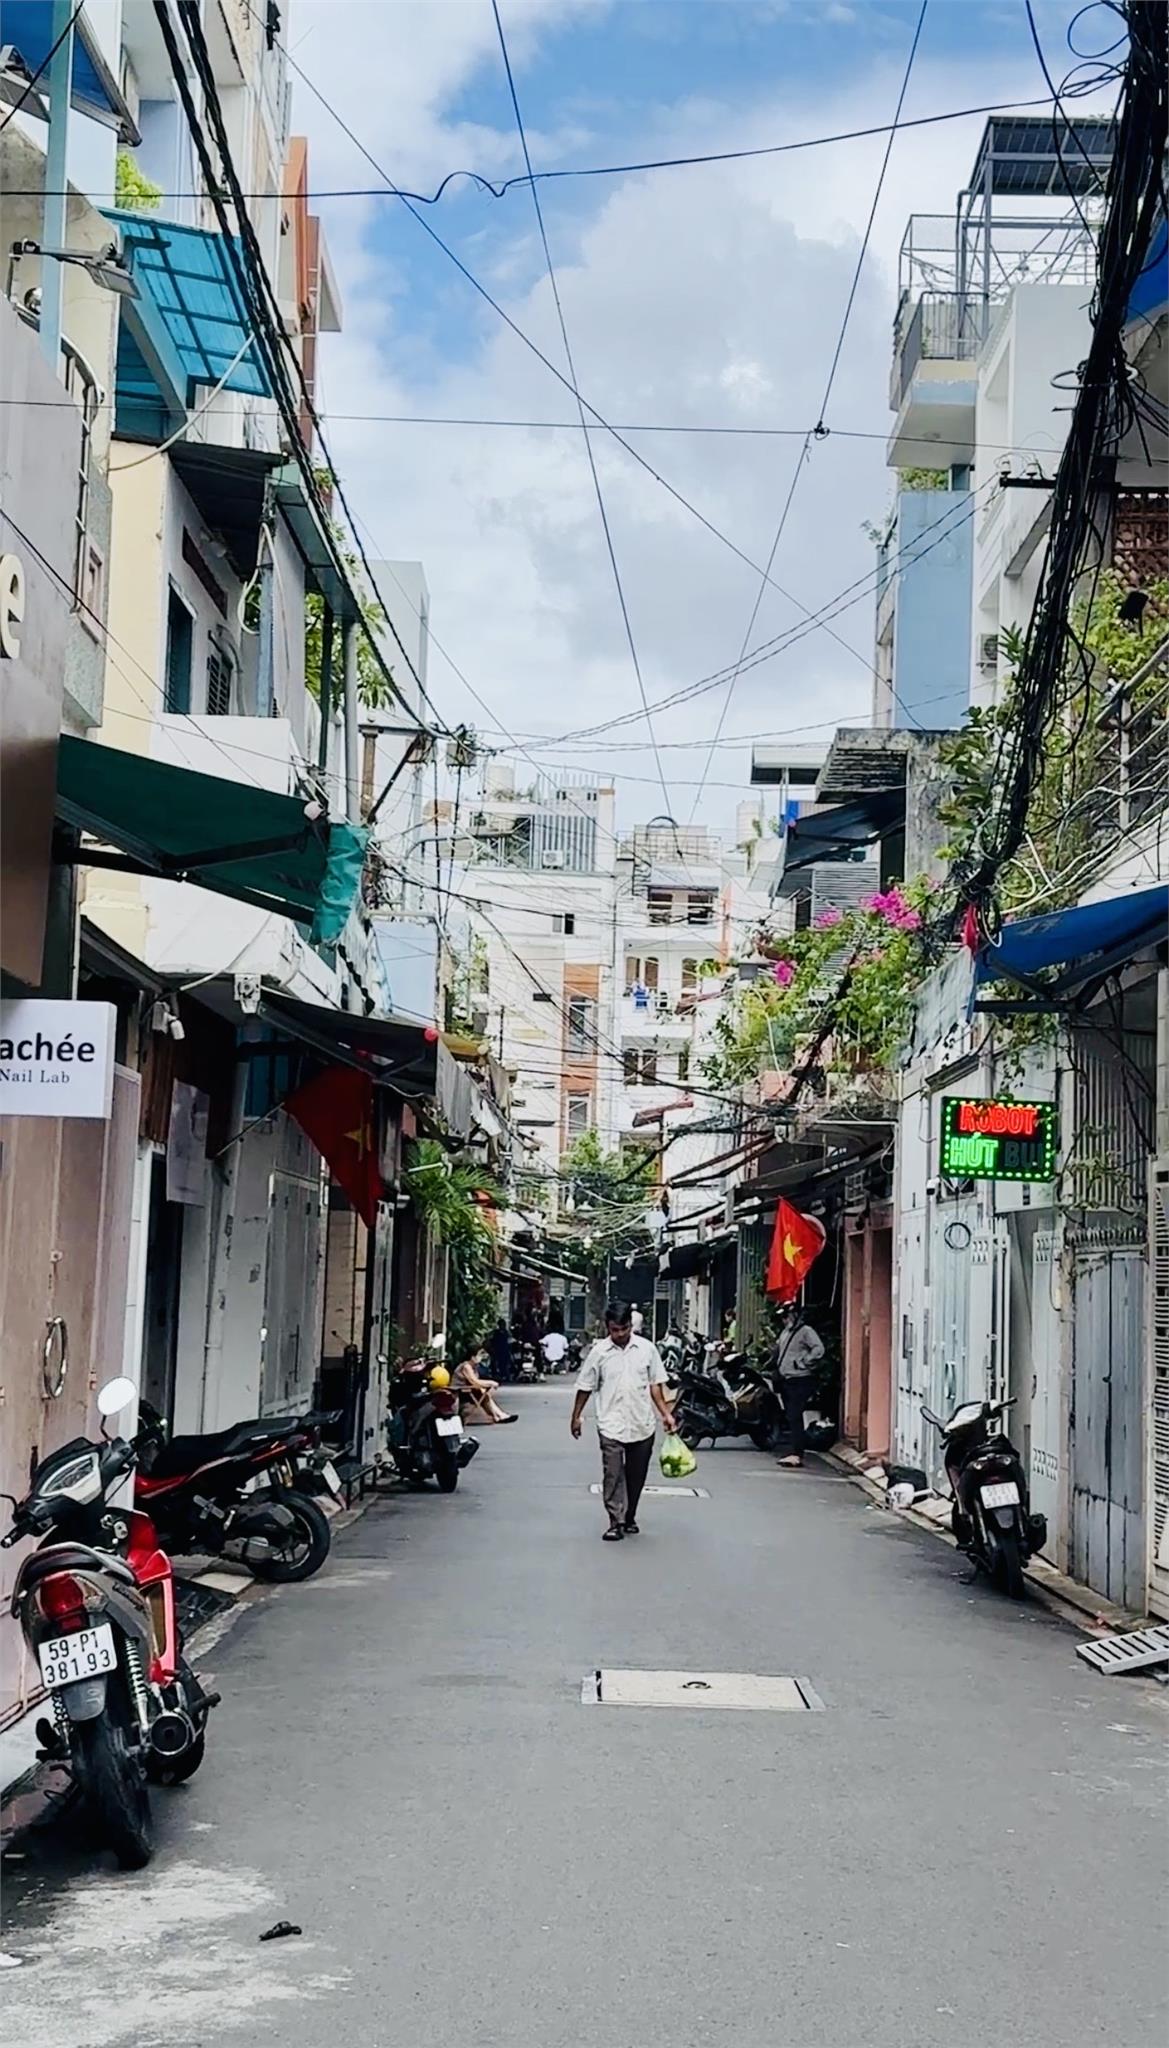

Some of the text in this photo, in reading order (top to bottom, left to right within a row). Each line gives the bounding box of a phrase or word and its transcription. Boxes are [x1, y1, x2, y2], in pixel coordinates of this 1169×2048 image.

[0, 1032, 95, 1062] achée
[0, 1068, 70, 1083] Nail Lab
[960, 1103, 1038, 1135] ROBOT
[949, 1132, 999, 1168] HÚT
[48, 1630, 98, 1661] 59-P1
[45, 1649, 111, 1684] 381.93
